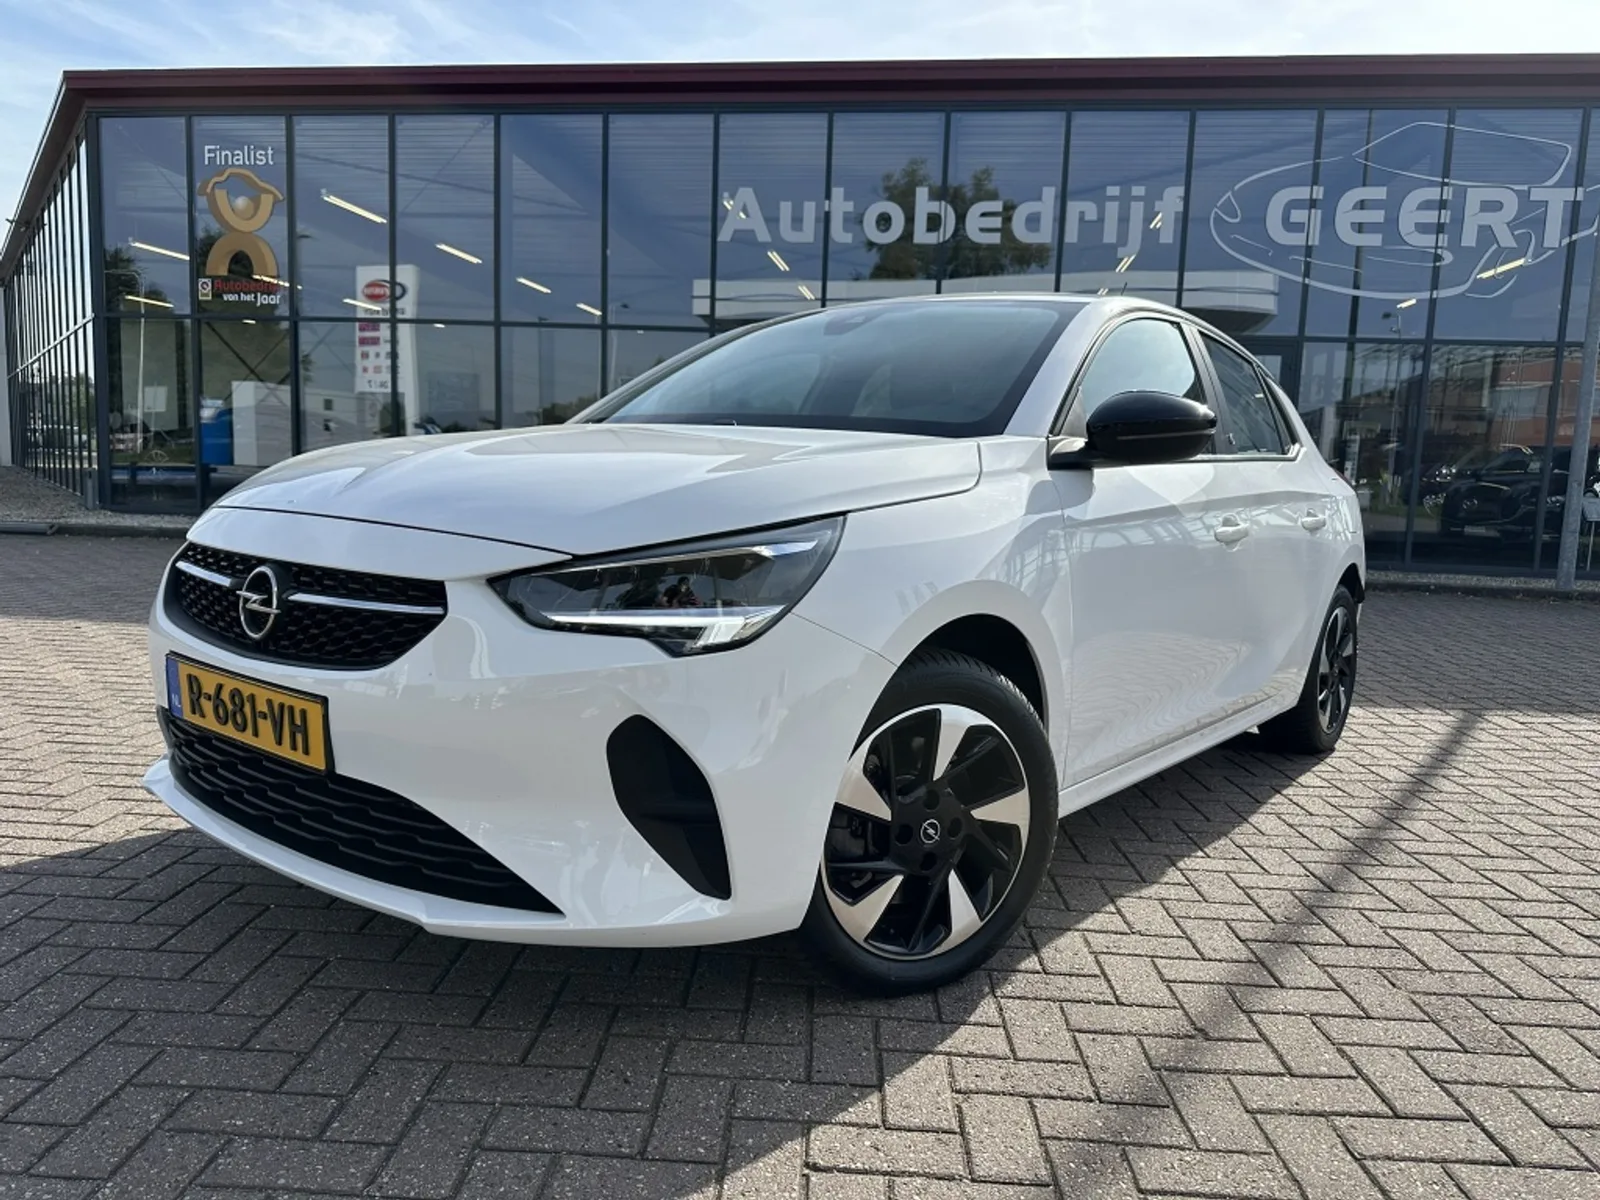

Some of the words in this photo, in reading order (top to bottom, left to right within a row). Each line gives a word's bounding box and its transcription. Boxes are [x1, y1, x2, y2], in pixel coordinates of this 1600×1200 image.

[204, 145, 274, 166] Finalist
[717, 186, 1185, 258] Autobedrijf
[1265, 185, 1584, 248] GEERT
[223, 293, 239, 301] van
[240, 292, 256, 301] het
[186, 673, 310, 756] R-681-VH
